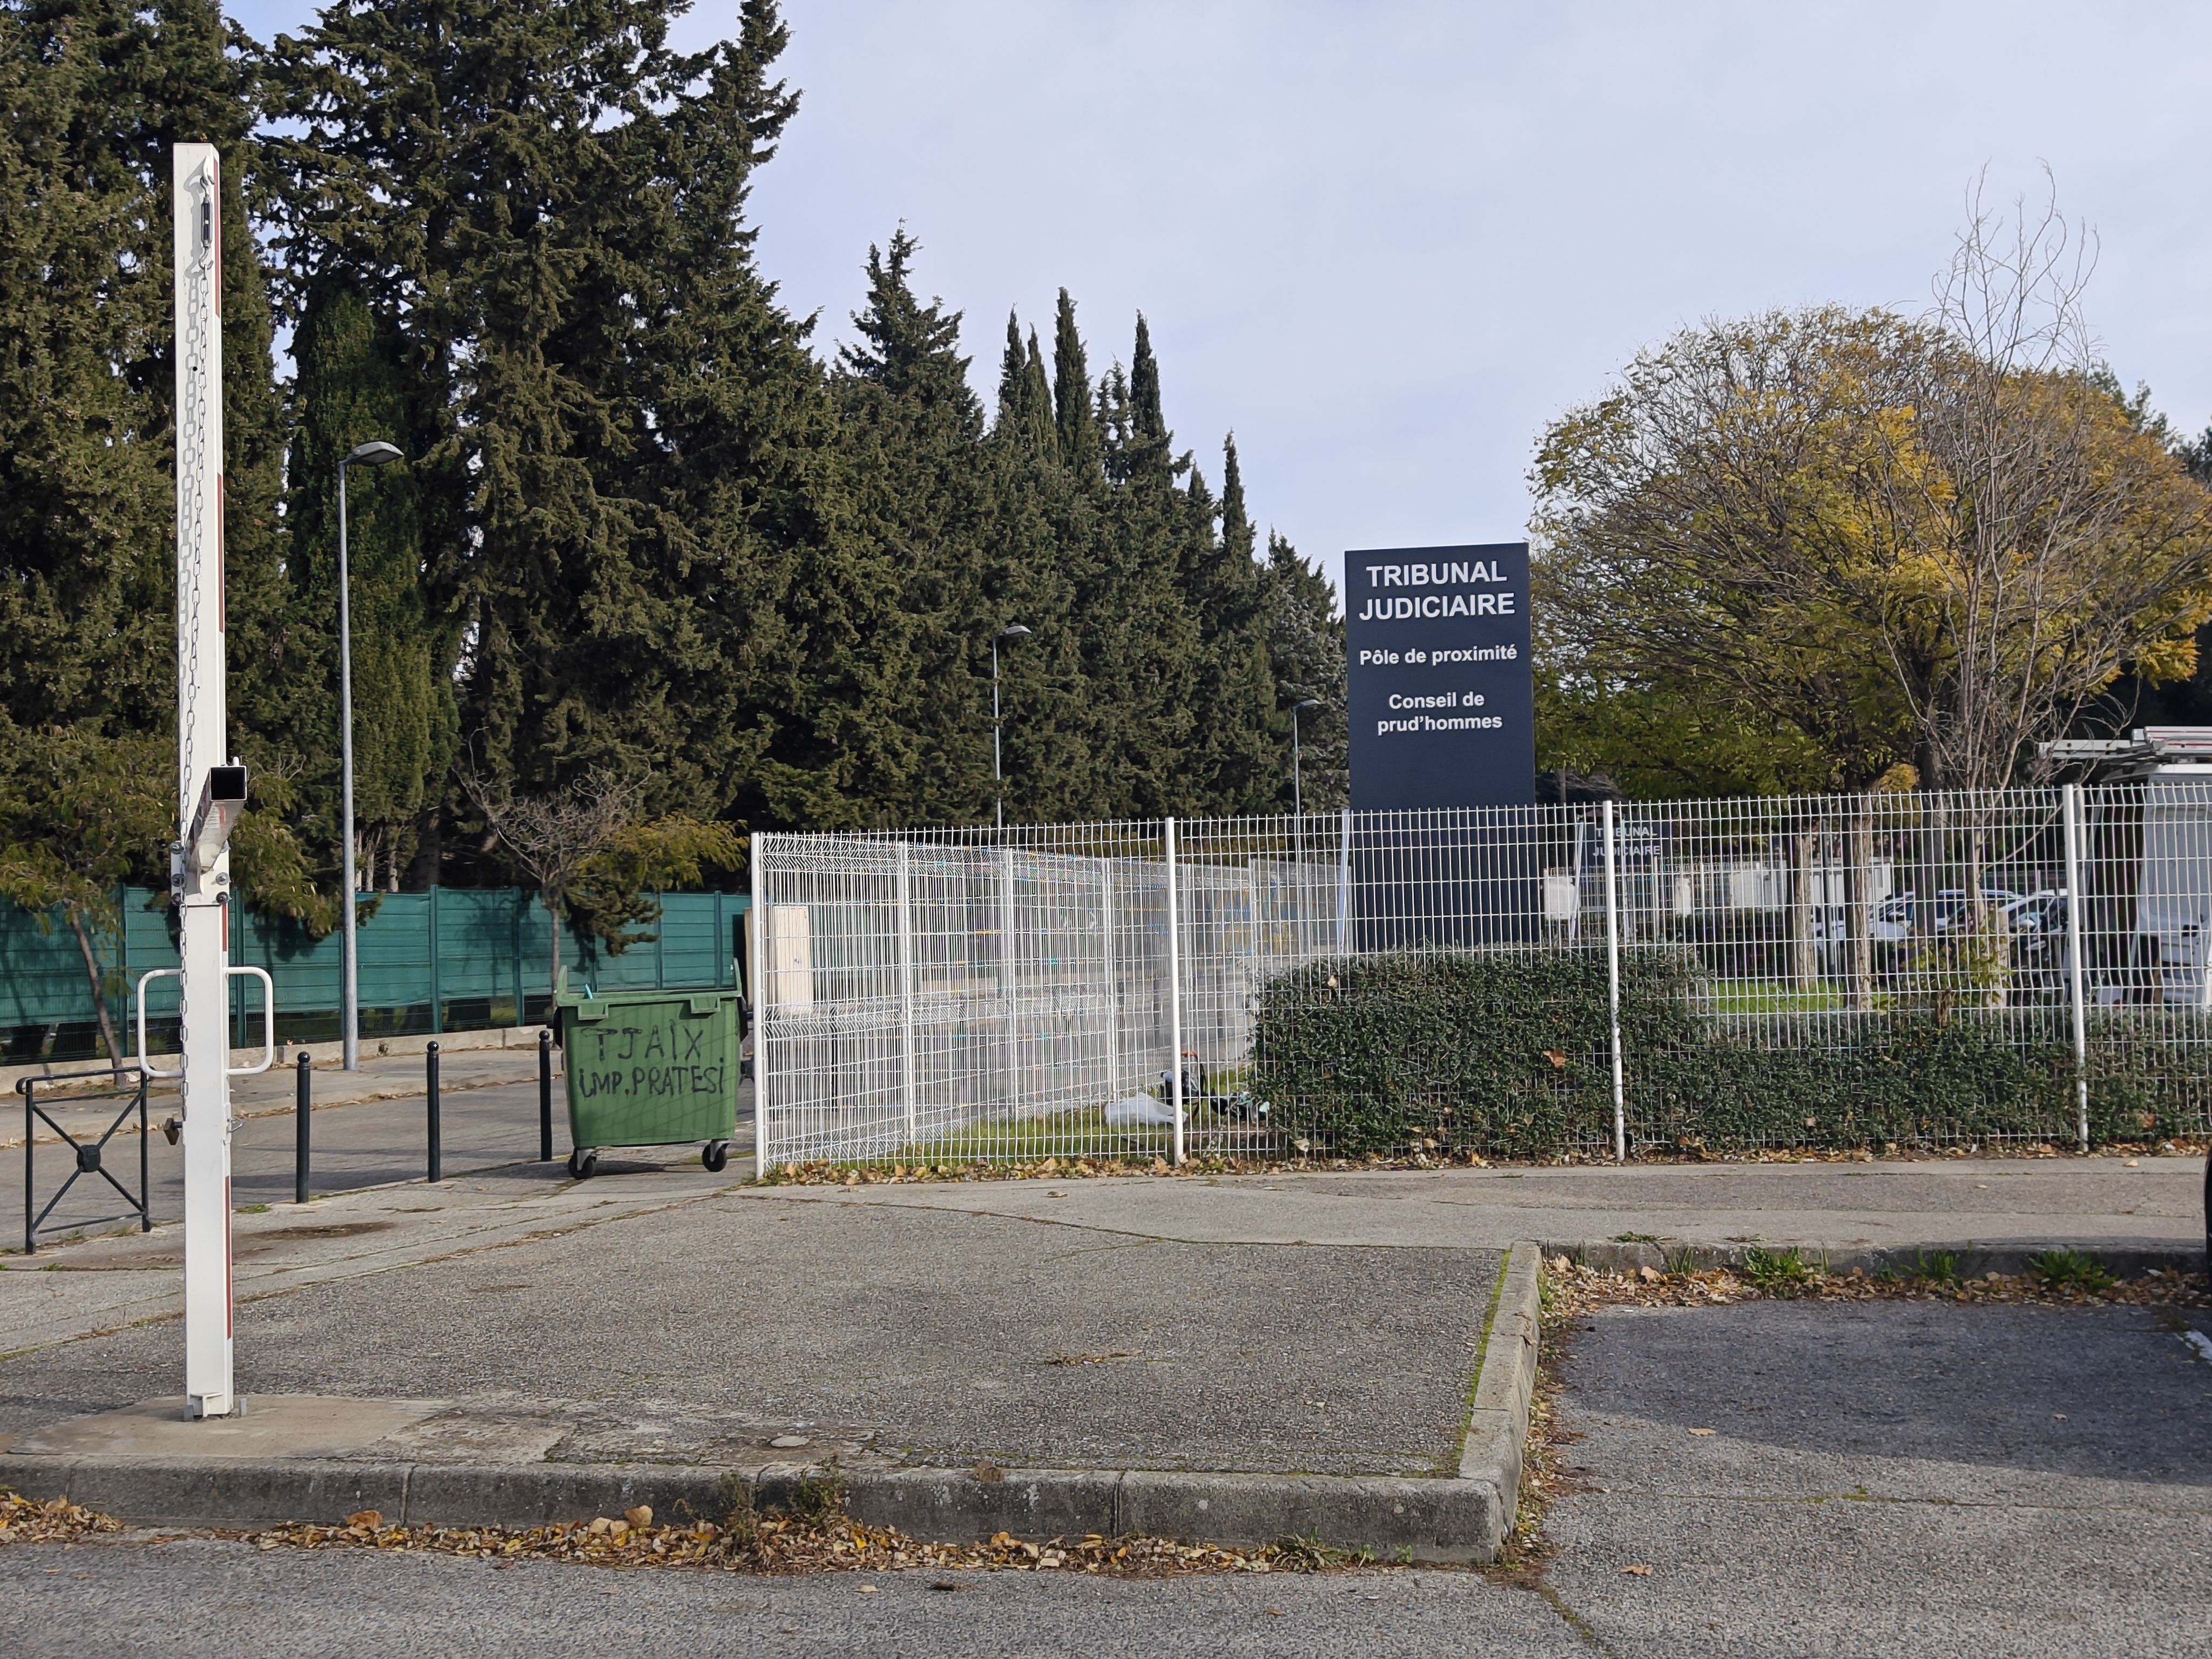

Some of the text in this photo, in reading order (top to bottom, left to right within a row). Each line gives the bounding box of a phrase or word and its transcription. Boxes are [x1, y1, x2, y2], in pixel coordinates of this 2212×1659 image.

[1366, 561, 1507, 587] TRIBUNAL
[1359, 592, 1515, 621] JUDICIAIRE
[1360, 644, 1518, 666] Pôle de proximité
[1389, 691, 1485, 709] Conseil de
[1378, 716, 1502, 736] prud’hommes
